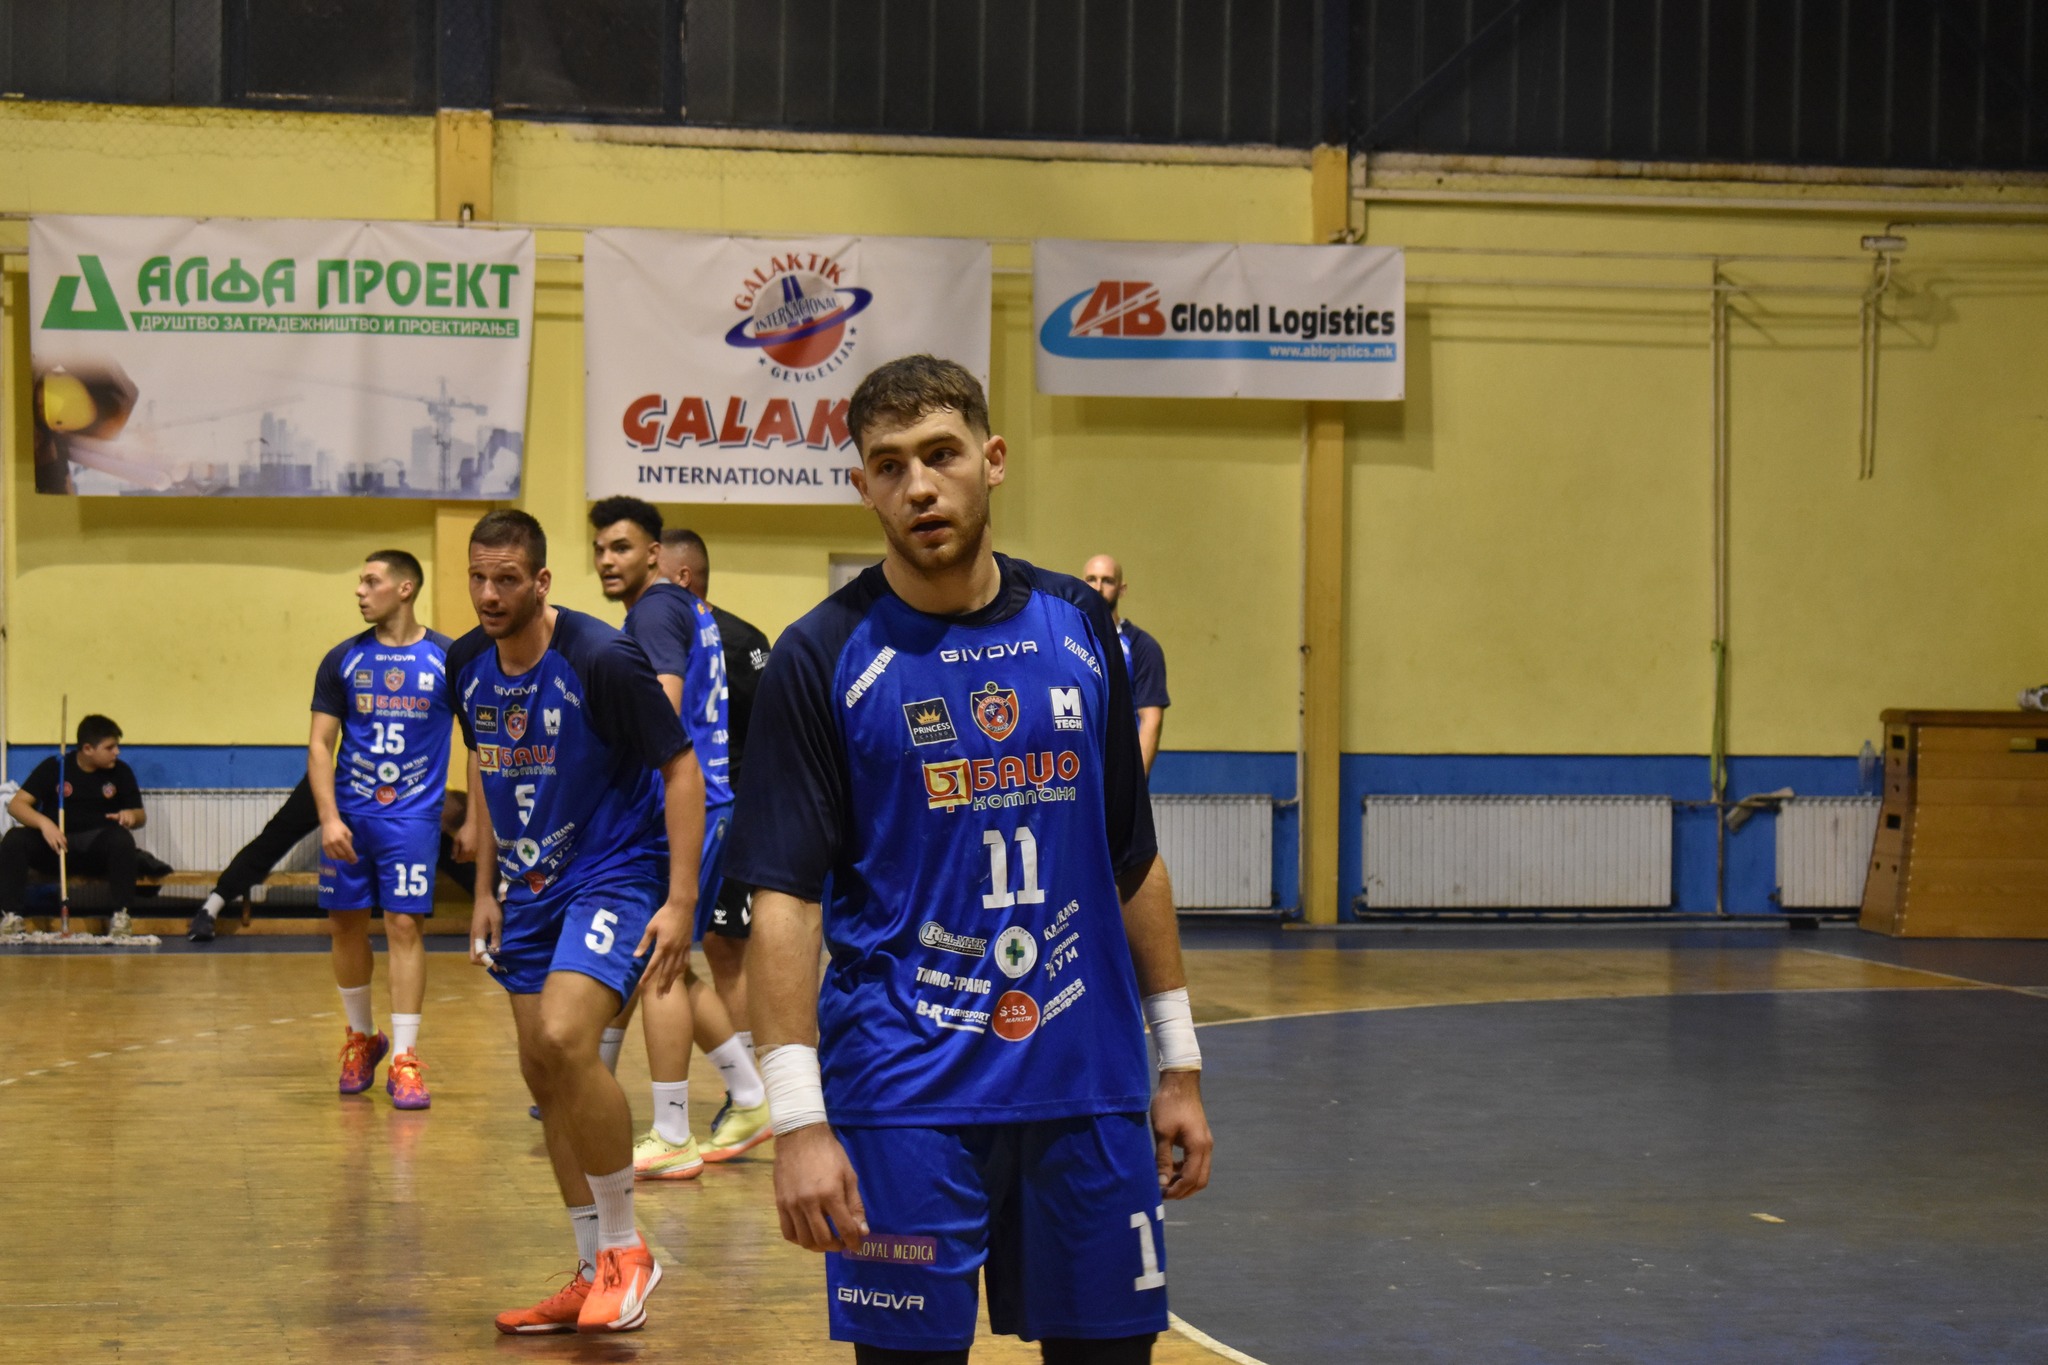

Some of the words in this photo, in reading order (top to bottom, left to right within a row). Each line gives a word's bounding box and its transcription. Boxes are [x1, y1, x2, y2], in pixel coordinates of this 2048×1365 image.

[138, 256, 296, 307] АЛФА
[317, 259, 520, 310] ПРОЕКТ
[734, 251, 846, 312] GALAKTIK
[140, 315, 220, 331] ДРУШТВО
[223, 316, 245, 330] ЗА
[249, 316, 380, 333] ГРАДЕЖНИШТВО
[384, 319, 395, 332] И
[400, 319, 516, 337] ПРОЕКТИРАЊЕ
[1171, 303, 1260, 333] Global
[1269, 304, 1395, 340] Logistics
[770, 341, 856, 383] GEVGELIJA
[1269, 345, 1394, 362] www.ablogistics.mk
[638, 465, 824, 486] INTERNATIONAL
[940, 640, 1038, 663] GIVOVA
[1063, 635, 1090, 662] VANE
[494, 683, 538, 697] GIVOVA
[1050, 688, 1081, 717] M
[913, 721, 951, 736] PRINCESS
[1055, 717, 1083, 730] TECH
[370, 722, 405, 755] 15
[515, 784, 536, 827] 5
[394, 863, 428, 897] 15
[982, 826, 1045, 909] 11
[585, 908, 619, 955] 5
[916, 966, 992, 995] ТИМО-ТРАНС
[944, 1007, 991, 1022] TRANSPORT
[1000, 1005, 1027, 1018] S-53
[857, 1241, 889, 1258] OYAL
[893, 1245, 934, 1261] MEDICA
[838, 1287, 925, 1311] GIVOVA
